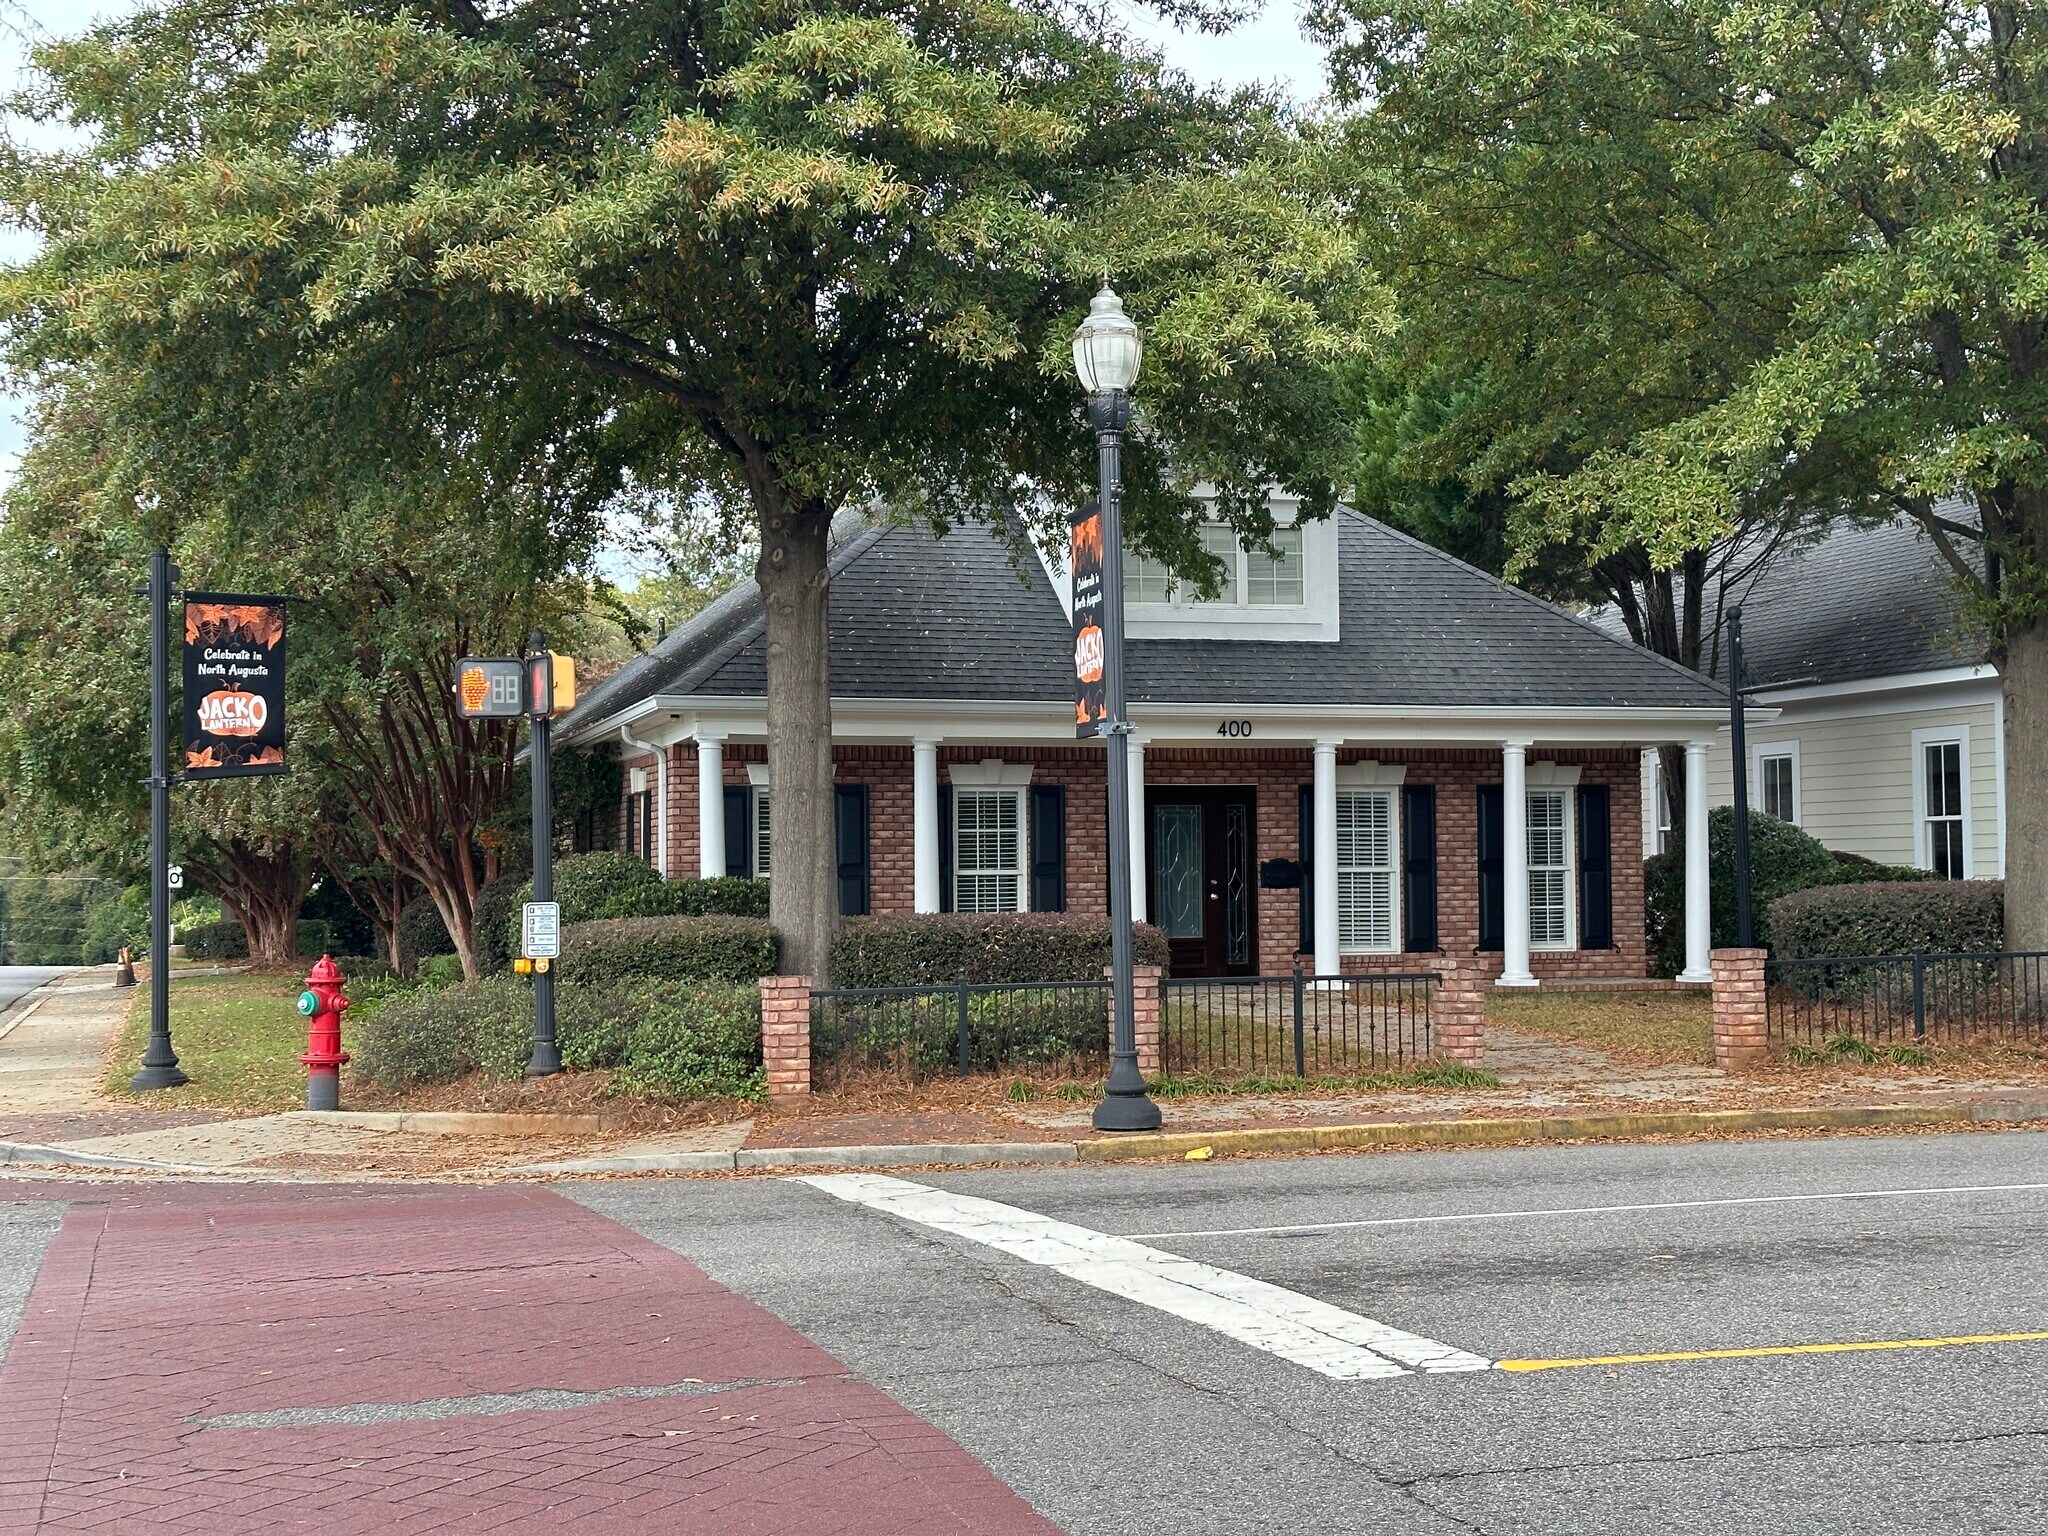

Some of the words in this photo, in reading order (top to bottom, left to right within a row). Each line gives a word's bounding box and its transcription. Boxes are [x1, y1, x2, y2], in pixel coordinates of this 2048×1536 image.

[204, 647, 250, 660] Celebrate
[252, 651, 262, 661] in
[197, 663, 226, 675] North
[228, 663, 268, 678] Augusta
[201, 717, 251, 731] LANTERN
[1217, 720, 1252, 737] 400
